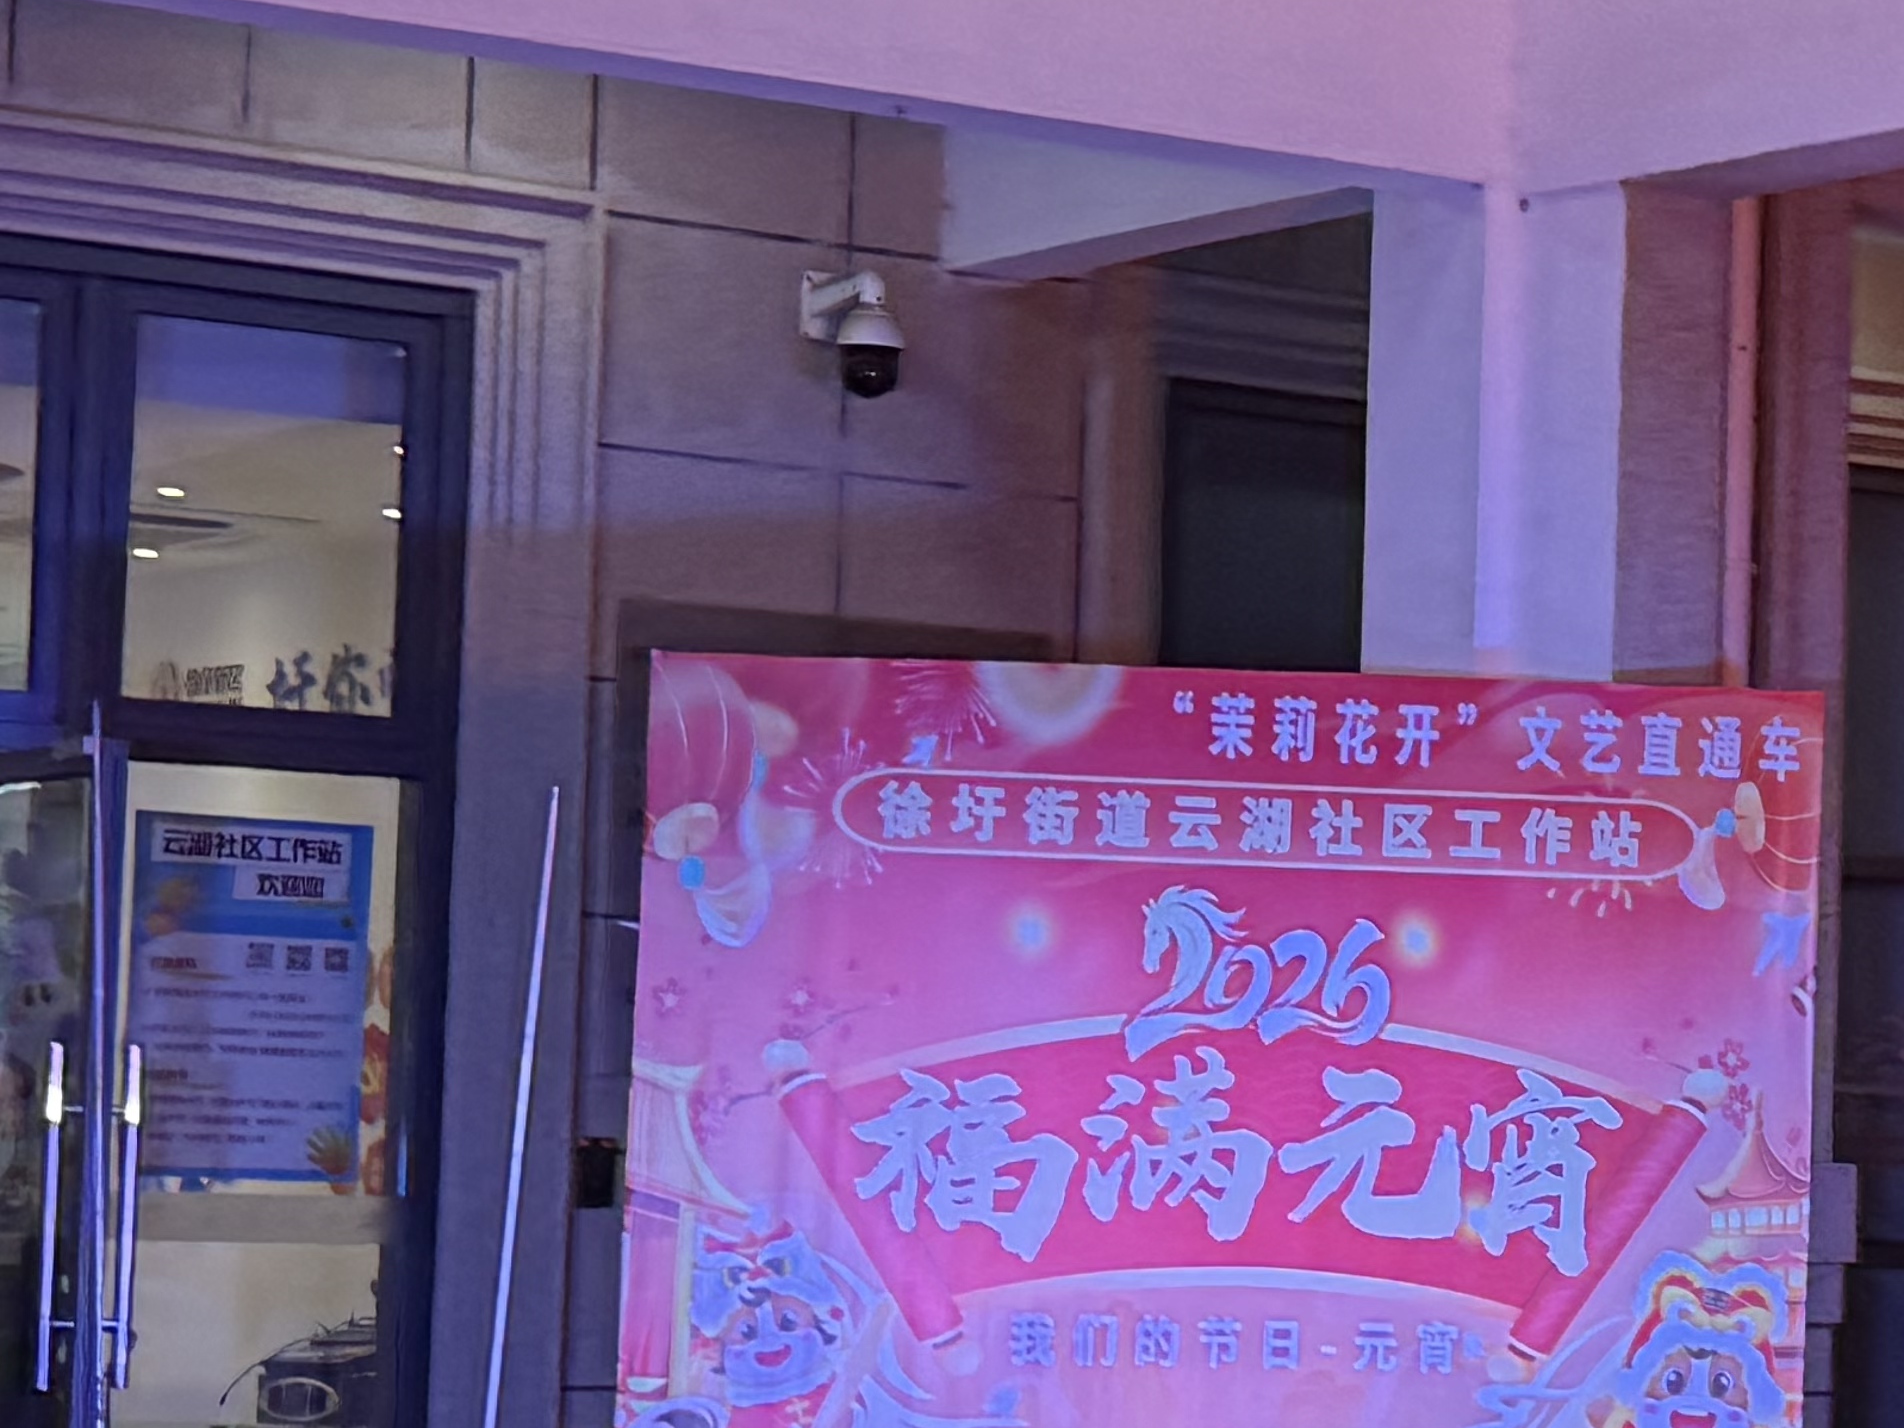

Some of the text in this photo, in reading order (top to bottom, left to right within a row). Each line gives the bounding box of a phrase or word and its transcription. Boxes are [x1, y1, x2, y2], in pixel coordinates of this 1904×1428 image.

[877, 779, 1645, 871] 徐圩街道云湖社区工作站
[1122, 884, 1394, 1060] 2026
[851, 1046, 1624, 1278] 福满元宵
